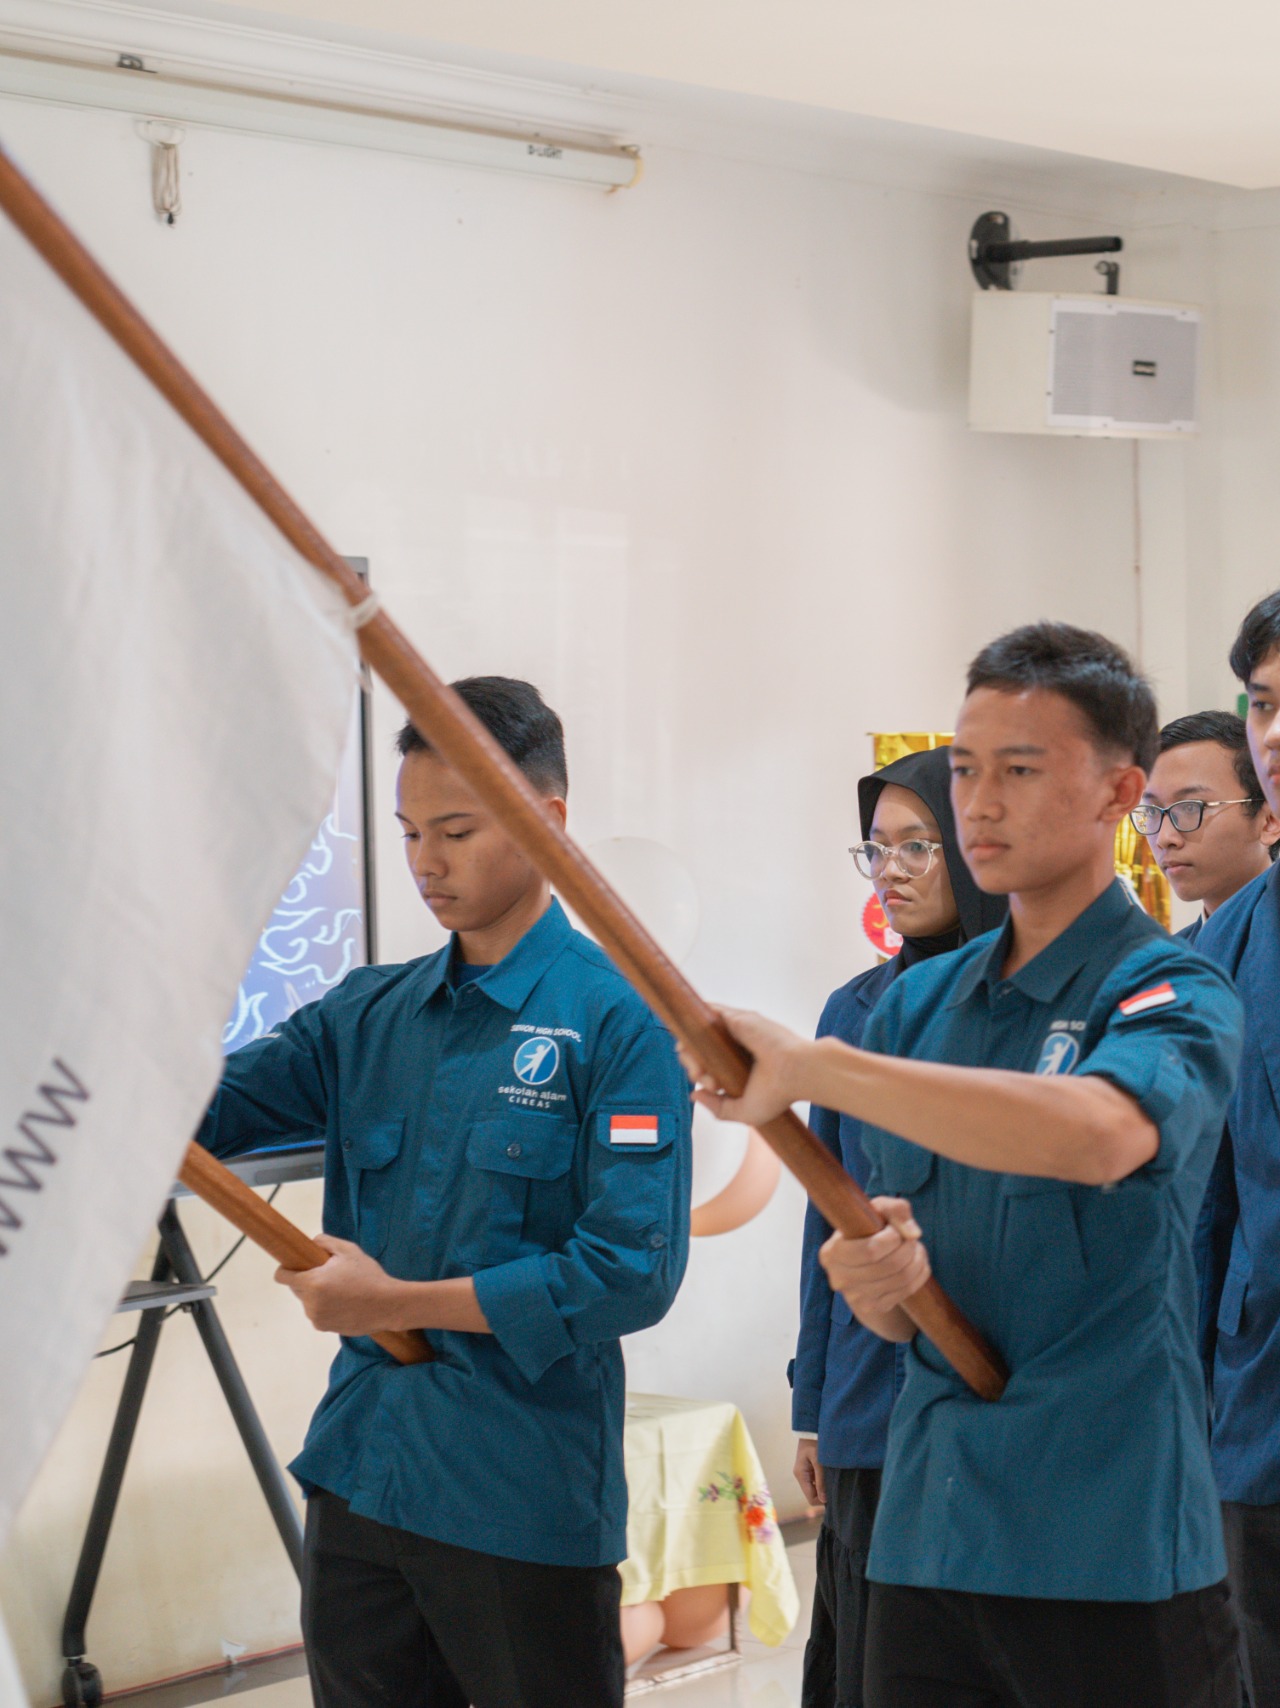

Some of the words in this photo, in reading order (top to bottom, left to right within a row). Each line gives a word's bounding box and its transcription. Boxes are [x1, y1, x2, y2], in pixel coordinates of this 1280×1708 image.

[535, 1026, 554, 1036] HIGH
[498, 1085, 539, 1098] sekolah
[539, 1091, 567, 1101] alam
[508, 1095, 551, 1109] CIKEAS
